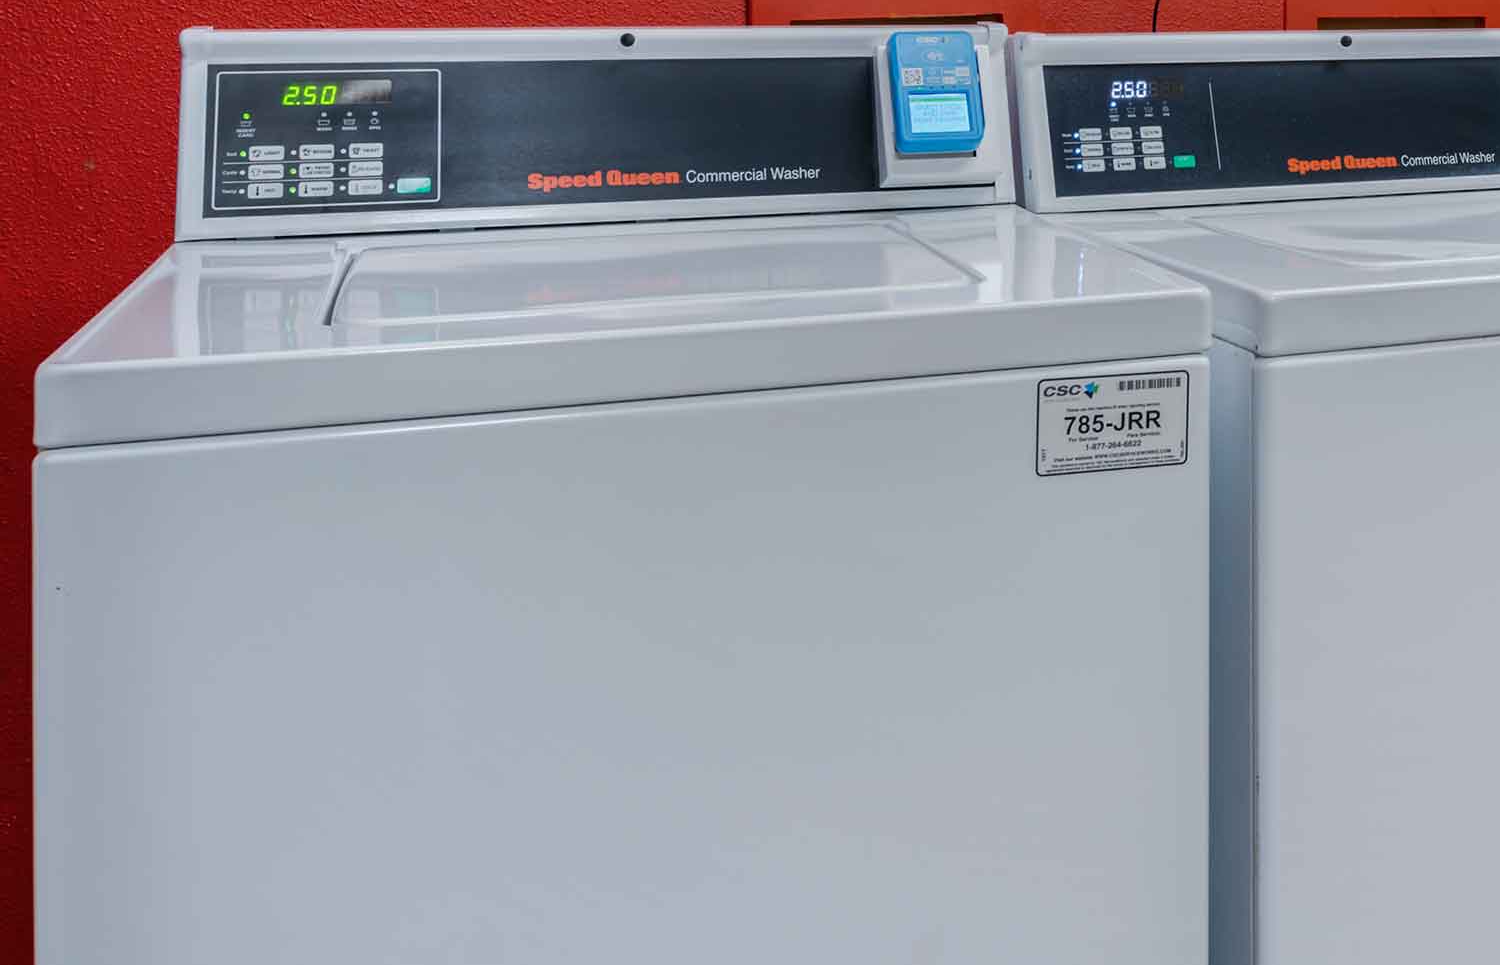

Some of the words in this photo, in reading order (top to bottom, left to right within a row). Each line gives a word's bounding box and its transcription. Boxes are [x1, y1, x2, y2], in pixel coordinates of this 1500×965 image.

[281, 84, 338, 107] 2.50
[1111, 80, 1148, 99] 2.50
[1287, 155, 1342, 176] Speed
[1343, 154, 1398, 170] Queen
[1400, 151, 1458, 168] Commercial
[1459, 150, 1496, 165] Washer
[527, 170, 601, 193] Speed
[606, 169, 681, 186] Queen
[686, 166, 768, 184] Commercial
[770, 166, 821, 181] Washer
[1043, 384, 1082, 397] CSC
[1063, 409, 1162, 436] 785-JRR
